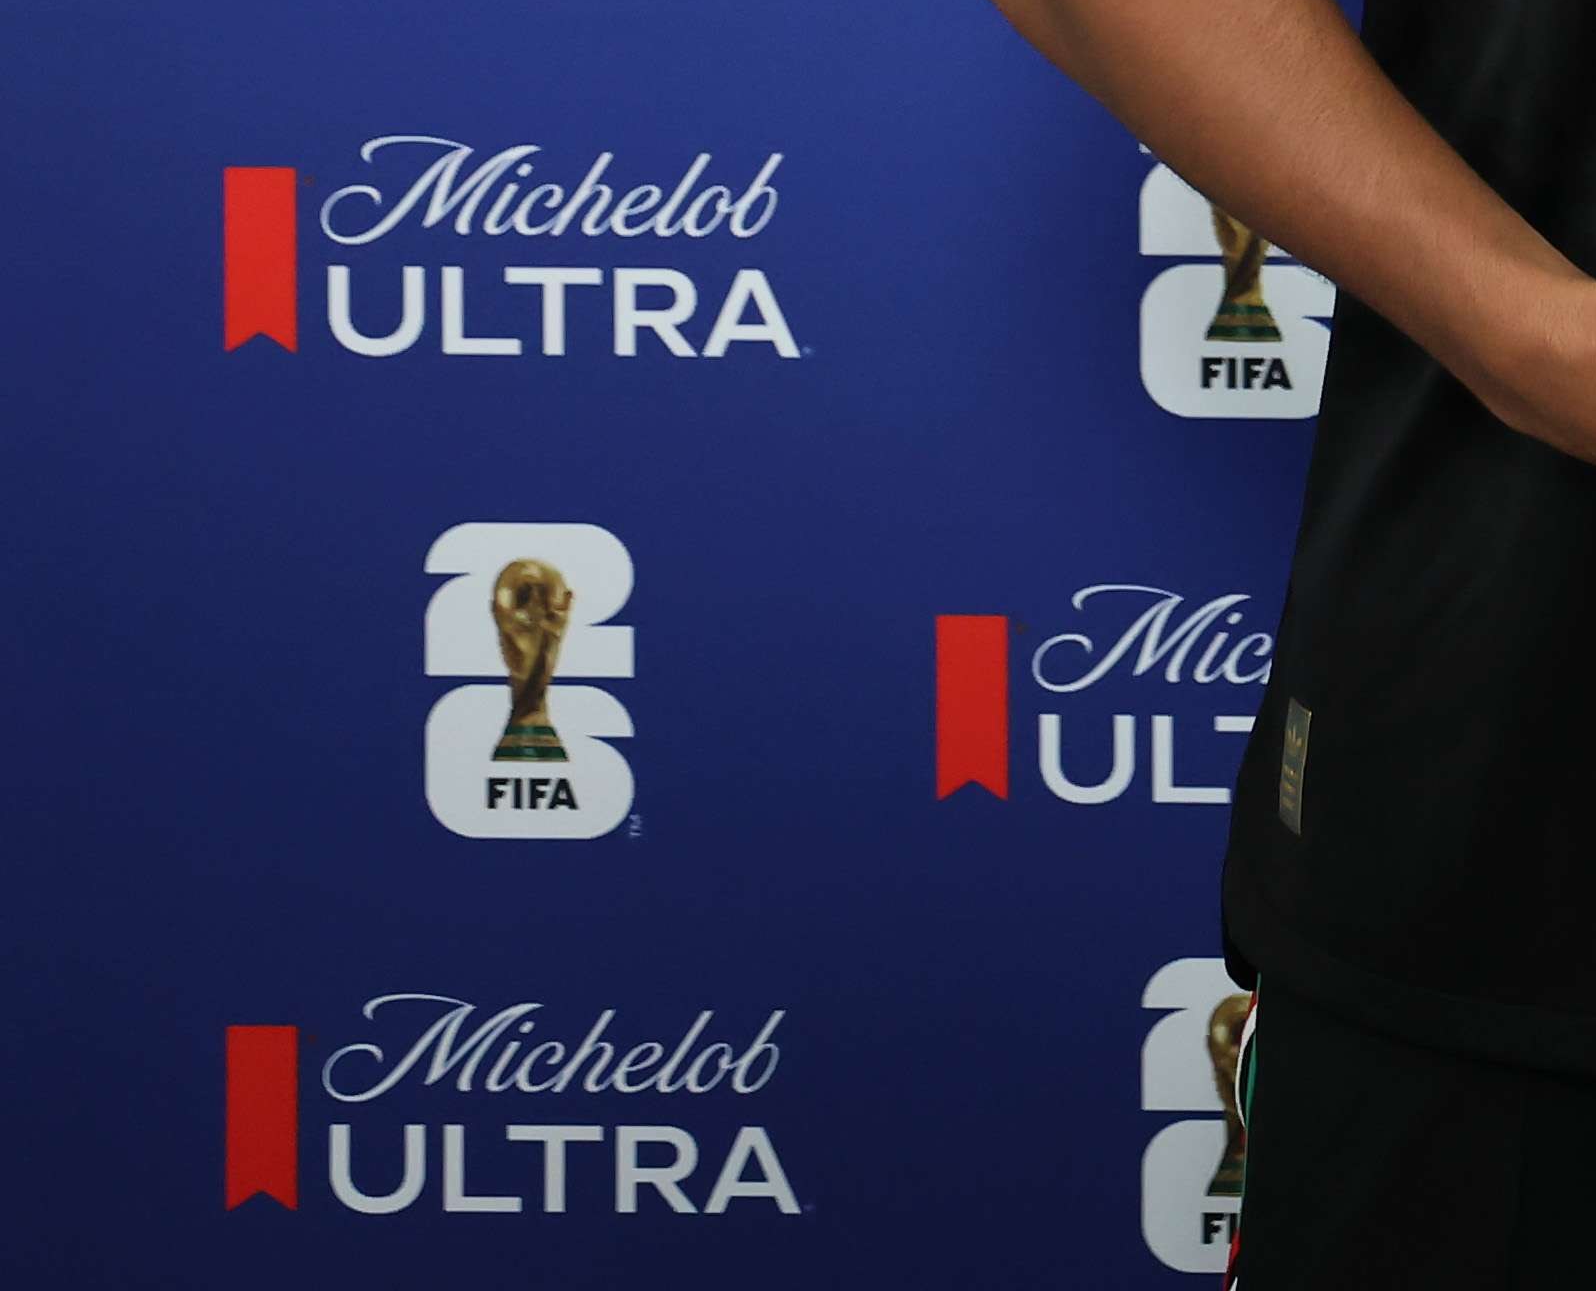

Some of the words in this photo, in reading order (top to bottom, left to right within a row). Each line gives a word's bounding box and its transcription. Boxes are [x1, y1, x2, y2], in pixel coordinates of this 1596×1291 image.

[321, 136, 783, 244] Michelob
[328, 266, 800, 358] ULTRA
[1201, 357, 1293, 390] FIFA
[487, 777, 578, 810] FIFA
[323, 994, 785, 1102] Michelob
[329, 1124, 801, 1214] ULTRA
[1201, 1212, 1241, 1245] FI
